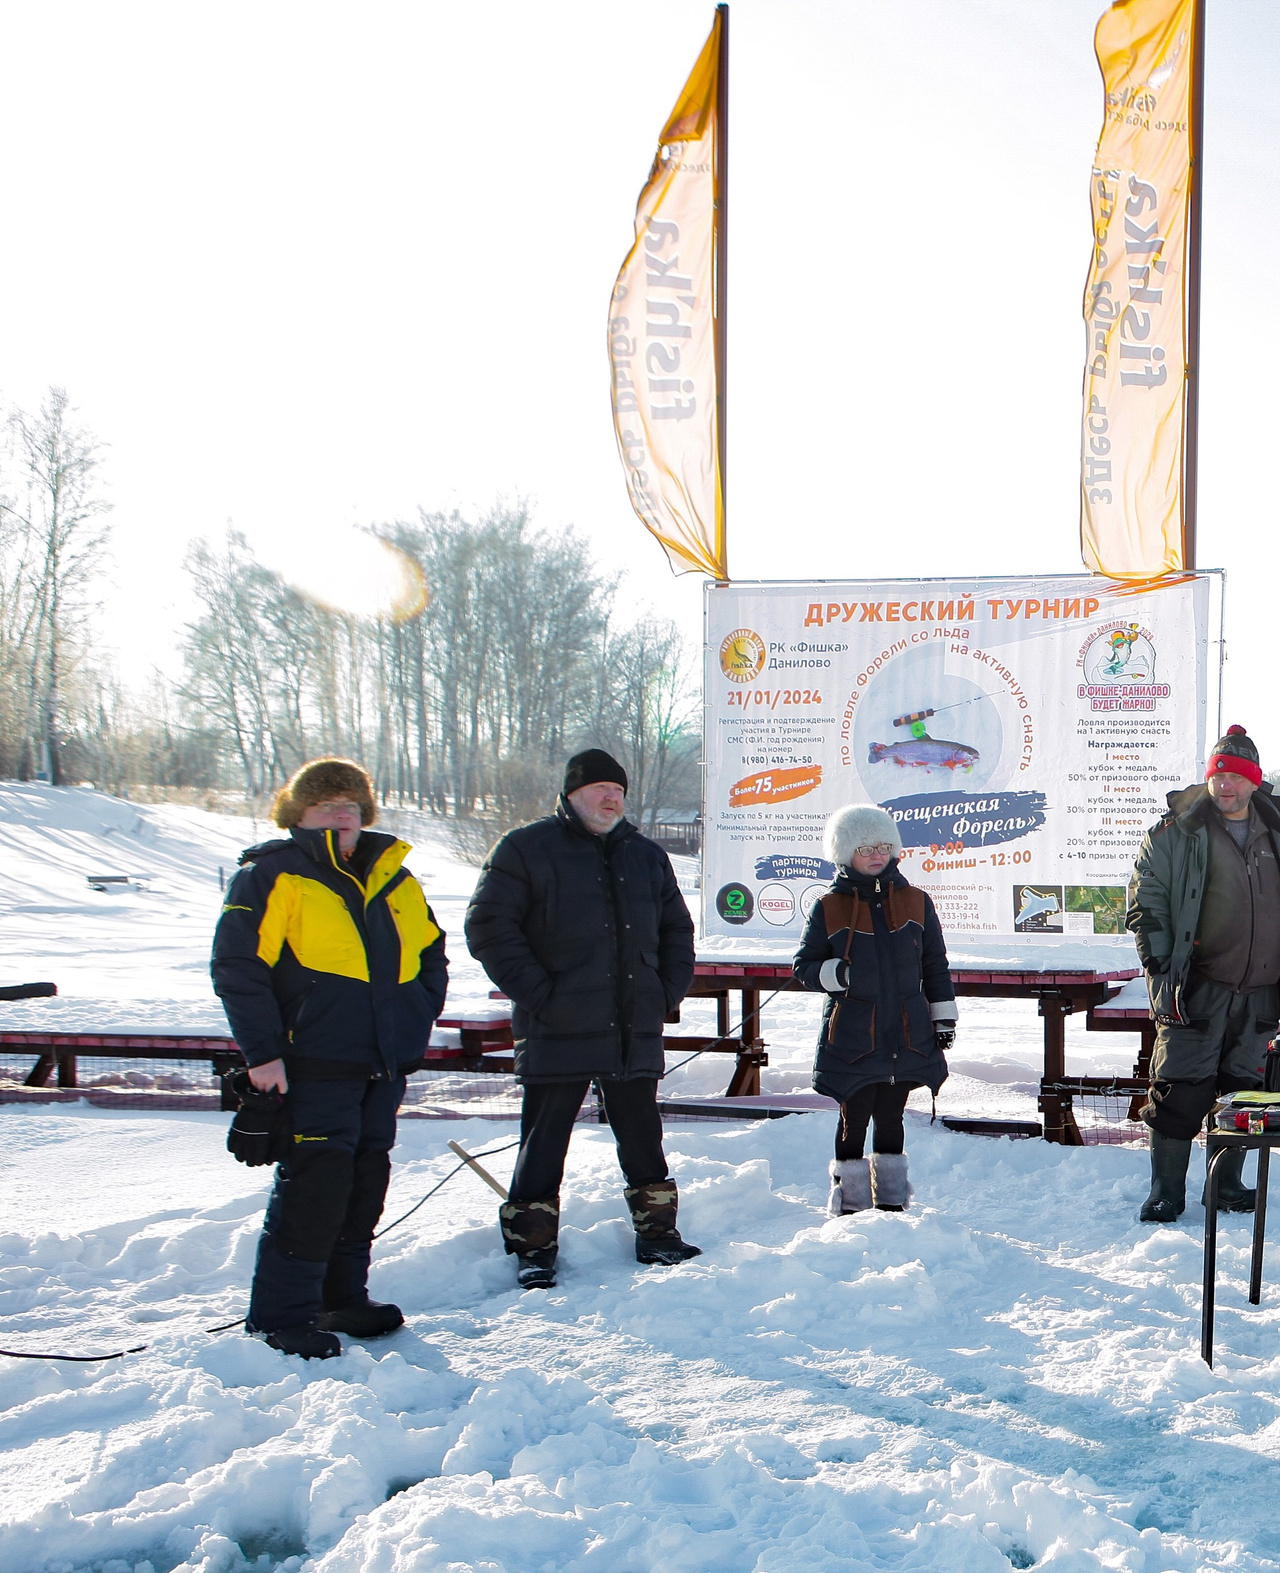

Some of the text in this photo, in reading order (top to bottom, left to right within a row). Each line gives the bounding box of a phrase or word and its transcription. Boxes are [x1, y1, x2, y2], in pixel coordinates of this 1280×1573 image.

[804, 593, 1100, 628] ДРУЖЕСКИЙ ТУРНИР
[769, 642, 785, 653] РК
[789, 641, 849, 654] «Фишка»
[768, 657, 831, 671] Данилово
[1079, 686, 1086, 696] В
[727, 689, 823, 711] 21/01/2024
[840, 628, 970, 766] по ловле Форели со льда
[950, 643, 1035, 772] на активную снасть
[1092, 699, 1154, 710] БУДЕТ ЖАРКО!
[718, 717, 765, 726] Регистрация
[773, 717, 836, 726] подтверждение
[1077, 719, 1171, 728] Ловля производится
[740, 727, 770, 736] участия
[778, 726, 812, 735] Турнире
[1095, 728, 1138, 736] активную
[727, 736, 825, 745] СМС (Ф.И. год рождения)
[1087, 740, 1159, 750] Награждается:
[768, 746, 793, 754] номер
[742, 755, 813, 766] 8(980) 416-74-50
[1088, 764, 1115, 772] кубок
[1068, 773, 1087, 781] 50%
[1101, 774, 1149, 782] призового
[1150, 773, 1181, 782] фонда
[734, 776, 815, 796] Более 75 участников
[1087, 796, 1114, 804] кубок
[1066, 805, 1086, 814] 30%
[1088, 806, 1098, 814] от
[1100, 806, 1148, 814] призового
[720, 812, 746, 821] Запуск
[757, 812, 763, 820] 5
[716, 823, 768, 832] Минимальный
[952, 816, 1037, 838] Форель»
[1087, 828, 1114, 836] кубок
[1124, 829, 1147, 837] меда
[730, 834, 754, 842] запуск
[767, 834, 796, 843] Турнир
[797, 834, 814, 842] 200
[1066, 838, 1086, 846] 20%
[1088, 838, 1098, 846] от
[930, 840, 965, 858] 9:00
[1067, 851, 1087, 859] 4-10
[772, 857, 822, 870] партнеры
[922, 858, 978, 874] Финиш
[990, 850, 1032, 867] 12:00
[775, 867, 818, 878] турнира
[941, 912, 980, 920] 333-19-14
